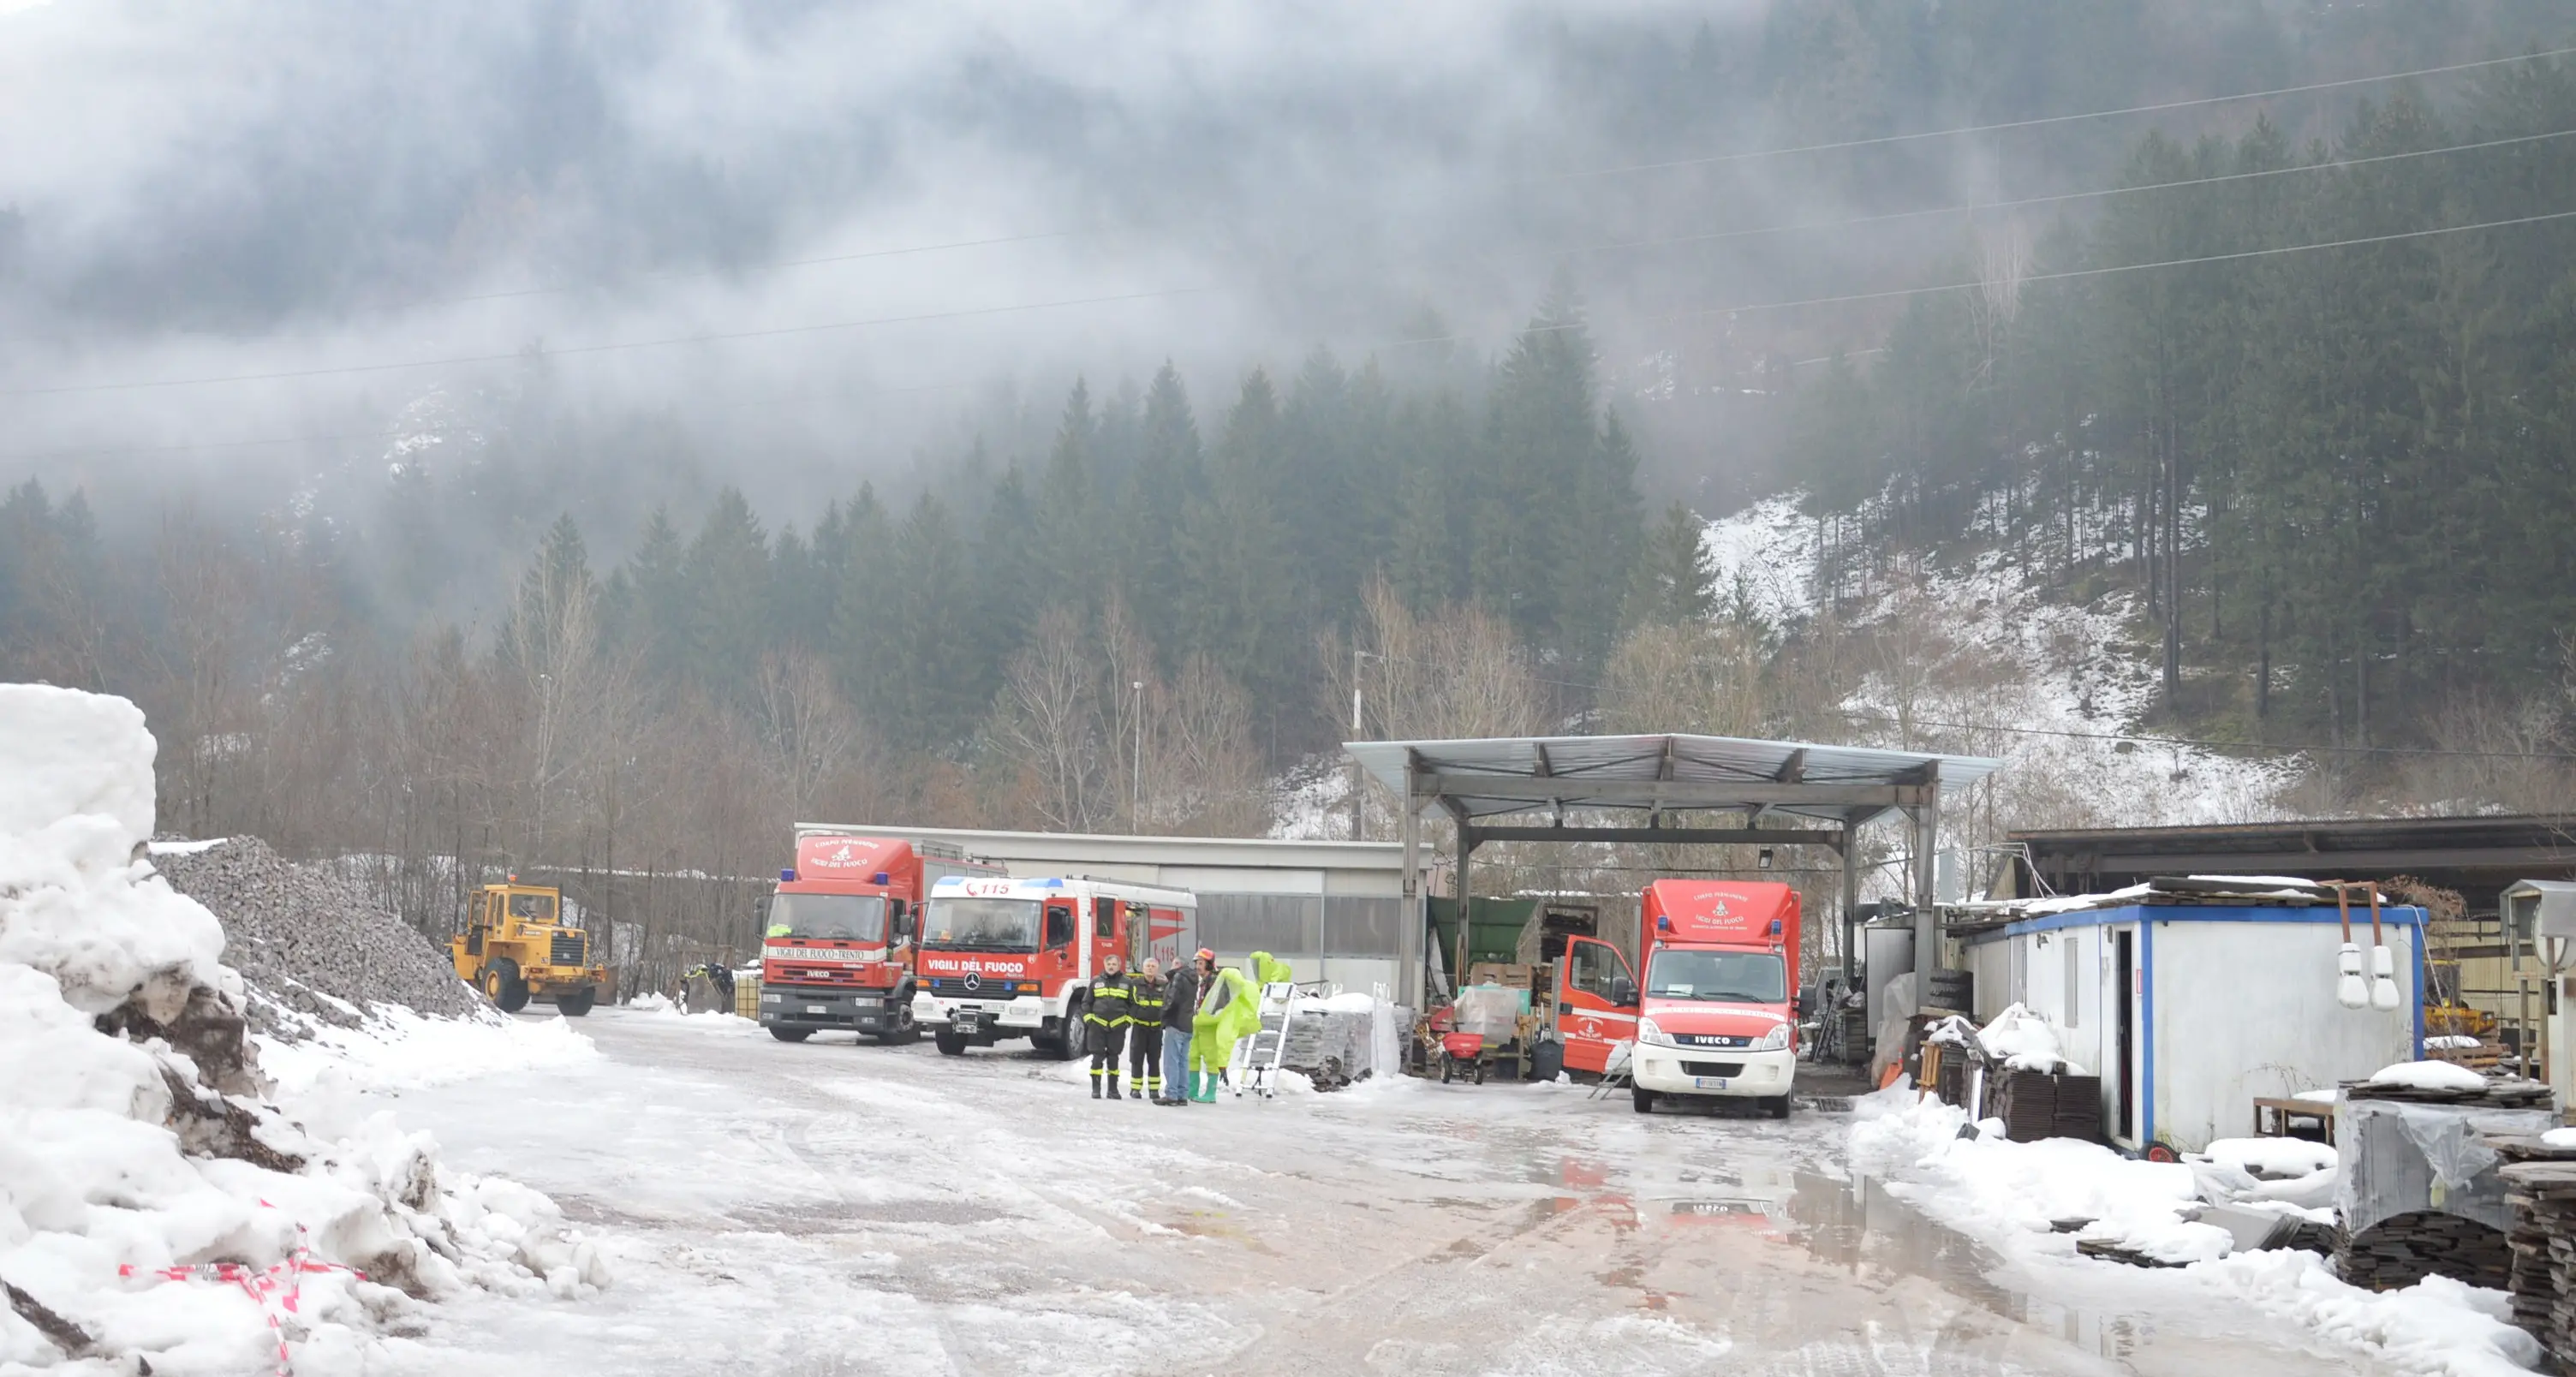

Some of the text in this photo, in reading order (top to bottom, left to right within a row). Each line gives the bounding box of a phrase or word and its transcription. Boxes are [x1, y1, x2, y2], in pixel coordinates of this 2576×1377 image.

[981, 884, 1010, 895] 115
[776, 948, 864, 959] VIGILI DEL FUOCO TRENTO
[1161, 945, 1175, 961] 115
[927, 959, 1024, 974] VIGILI DEL FUOCO
[1695, 1036, 1731, 1045] IVECO
